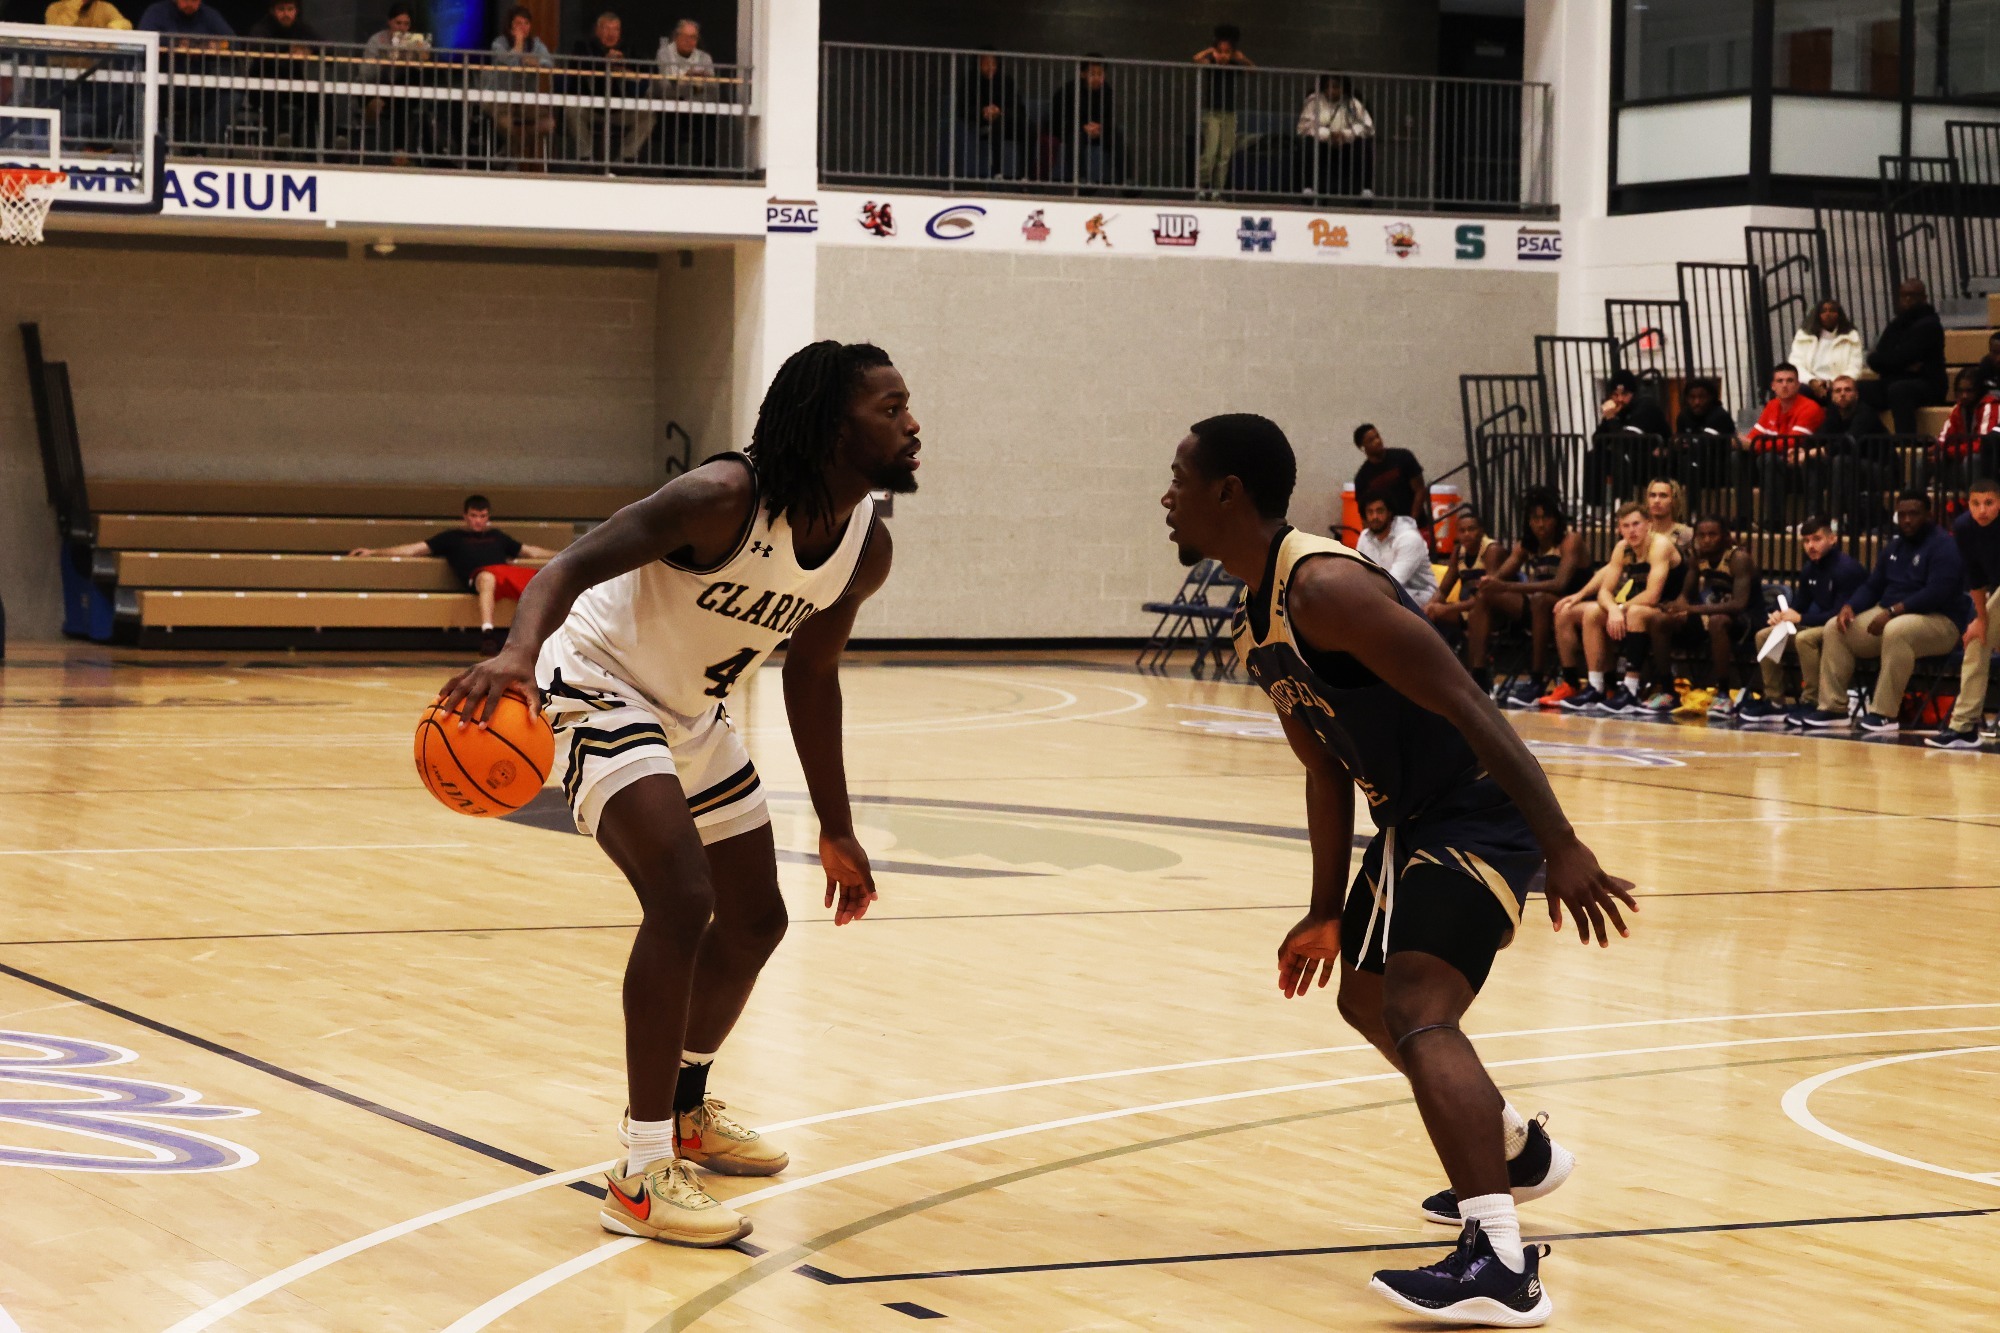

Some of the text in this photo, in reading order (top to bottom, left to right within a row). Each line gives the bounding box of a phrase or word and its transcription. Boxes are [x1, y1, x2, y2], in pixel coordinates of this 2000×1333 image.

[766, 207, 818, 224] PSAC
[1158, 214, 1198, 238] IUP
[1455, 225, 1486, 260] S
[1517, 236, 1562, 252] PSAC
[696, 581, 820, 634] CLARIO
[704, 647, 761, 698] 4
